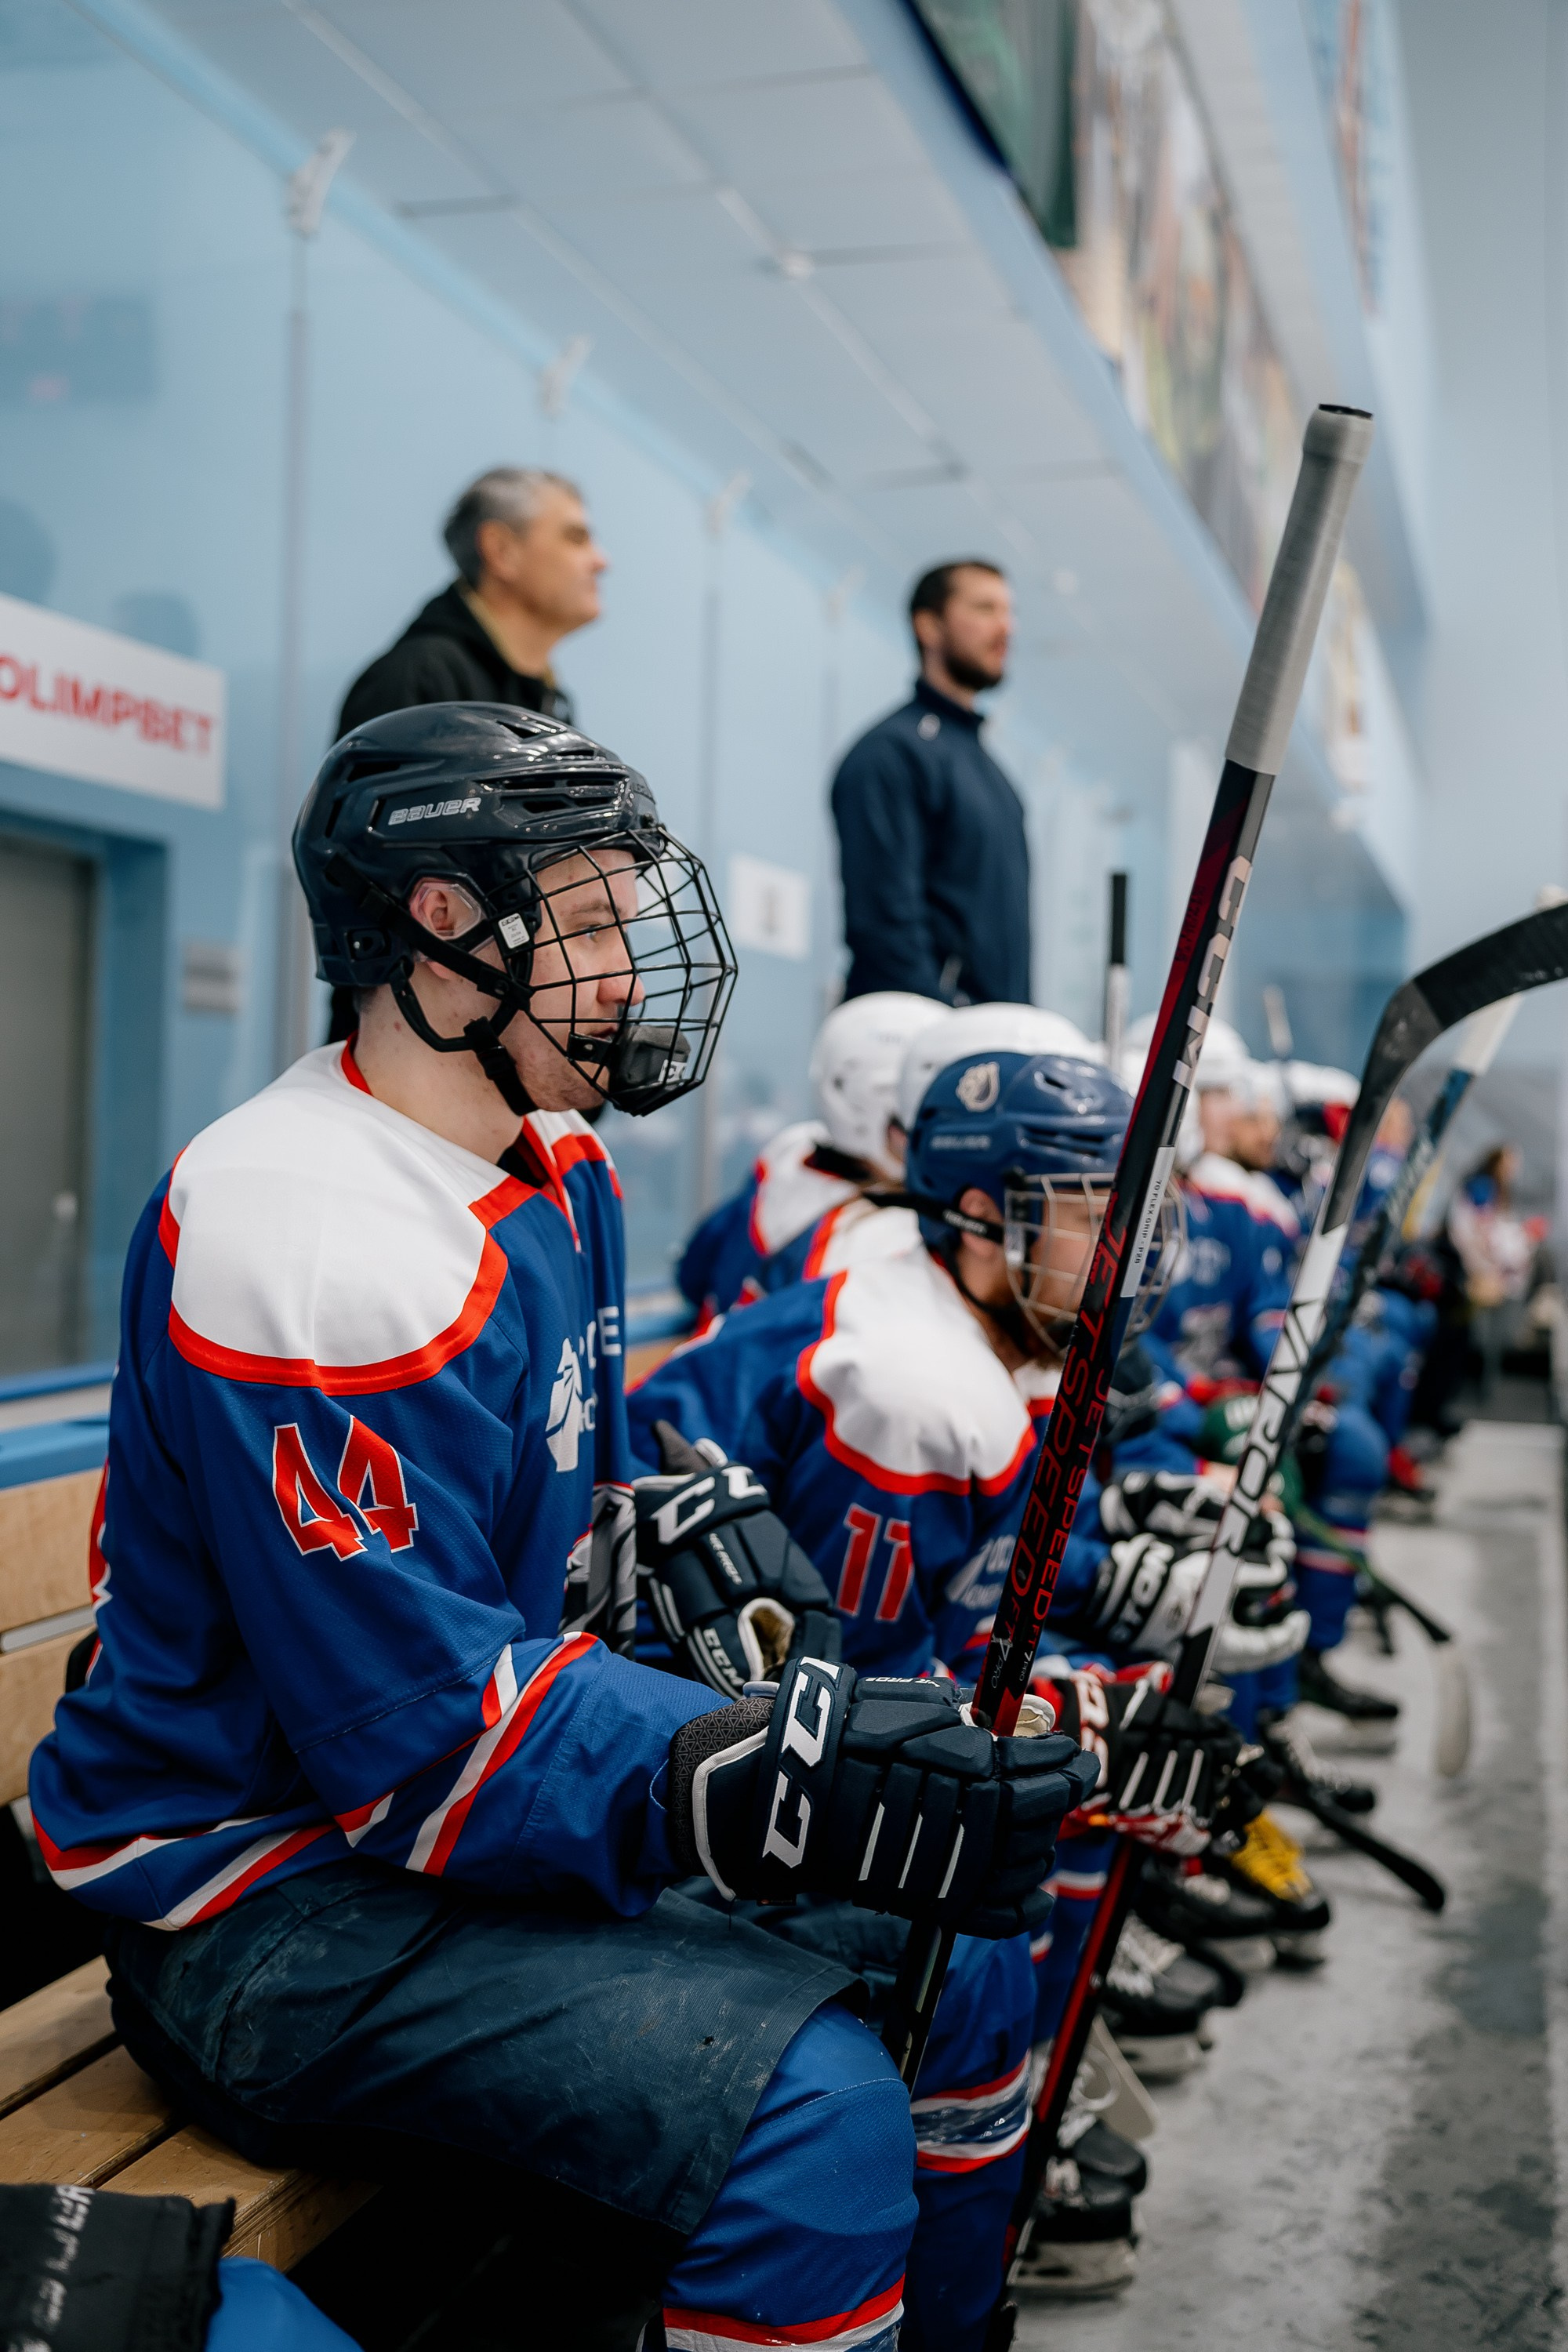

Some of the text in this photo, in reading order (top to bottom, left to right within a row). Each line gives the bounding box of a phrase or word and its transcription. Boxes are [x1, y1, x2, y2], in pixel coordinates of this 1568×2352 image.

[273, 1414, 419, 1562] 44
[1011, 1191, 1127, 1596] JETSPEED
[1034, 1369, 1110, 1620] JETSPEED
